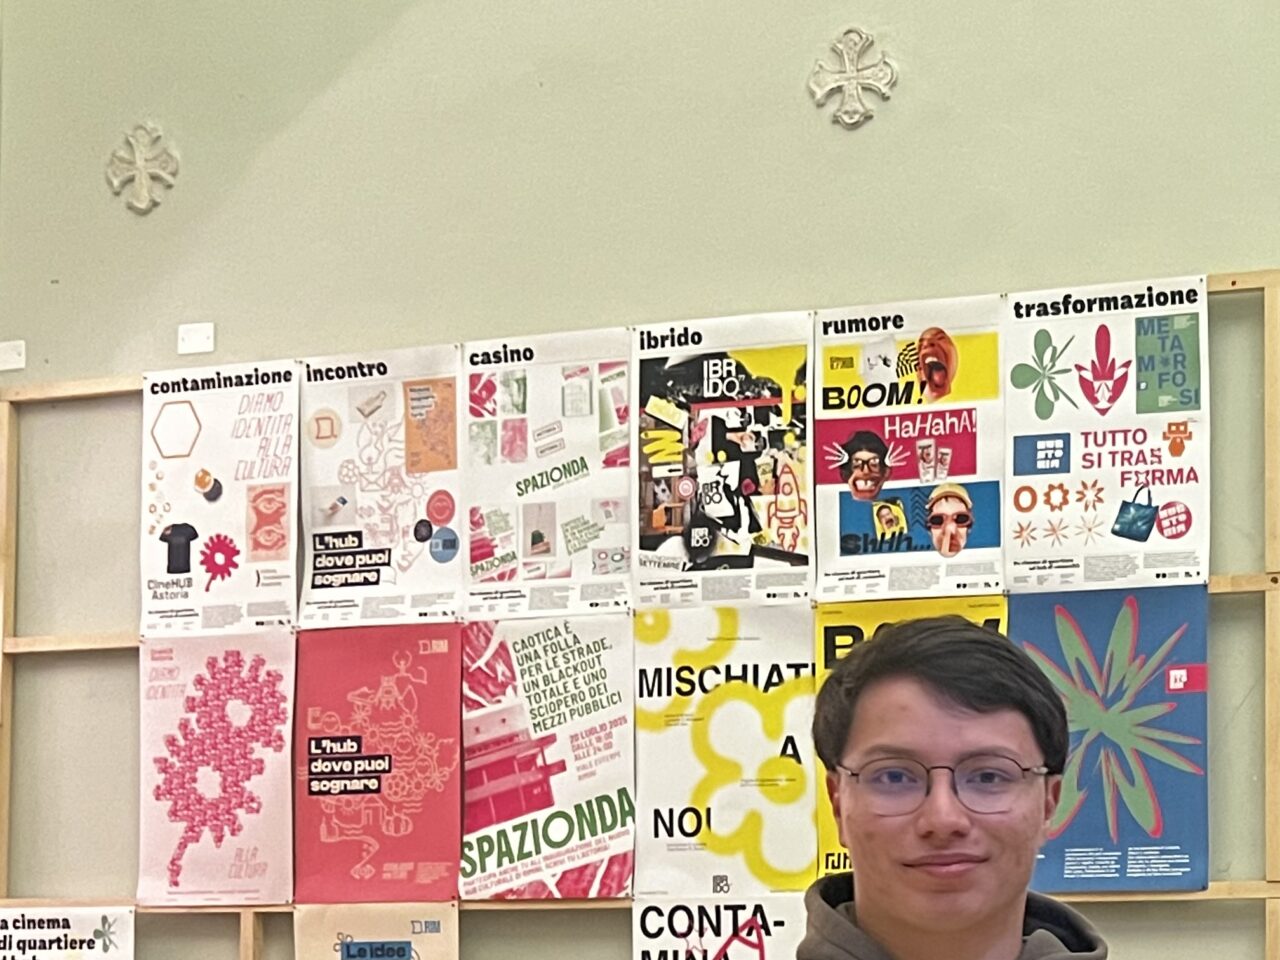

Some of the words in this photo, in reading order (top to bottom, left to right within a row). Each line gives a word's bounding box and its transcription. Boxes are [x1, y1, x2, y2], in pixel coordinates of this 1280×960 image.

[1013, 287, 1199, 320] trasformazione
[822, 314, 905, 336] rumore
[640, 328, 703, 350] ibrido
[1157, 335, 1184, 353] TA
[469, 344, 535, 366] casino
[150, 368, 293, 395] contaminazione
[306, 361, 387, 382] incontro
[1158, 371, 1186, 389] FO
[822, 380, 927, 410] BOOM!
[1081, 428, 1147, 449] TUTTO
[1081, 453, 1101, 470] SI
[516, 456, 589, 497] SPAZIONDA
[315, 555, 352, 568] dove
[314, 571, 379, 587] sognare
[512, 626, 562, 653] CAOTICA
[516, 651, 541, 667] UNA
[544, 633, 581, 657] FOLLA
[520, 662, 544, 680] PER
[546, 656, 560, 671] LE
[523, 677, 541, 694] UN
[543, 654, 602, 688] BLACKOUT
[525, 680, 571, 708] TOTALE
[574, 674, 581, 687] E
[583, 667, 607, 685] UNO
[529, 687, 587, 720] SCIOPERO
[589, 682, 608, 700] DEI
[532, 712, 567, 735] MEZZI
[570, 691, 622, 721] PUBBLICI
[780, 735, 802, 765] A
[310, 760, 351, 774] dove
[310, 777, 379, 793] sognare
[460, 786, 635, 879] SPAZIONDA
[13, 914, 71, 930] cinema
[639, 904, 785, 939] CONTA-
[17, 934, 96, 955] quartiere
[345, 943, 368, 959] Le
[370, 941, 406, 959] idee
